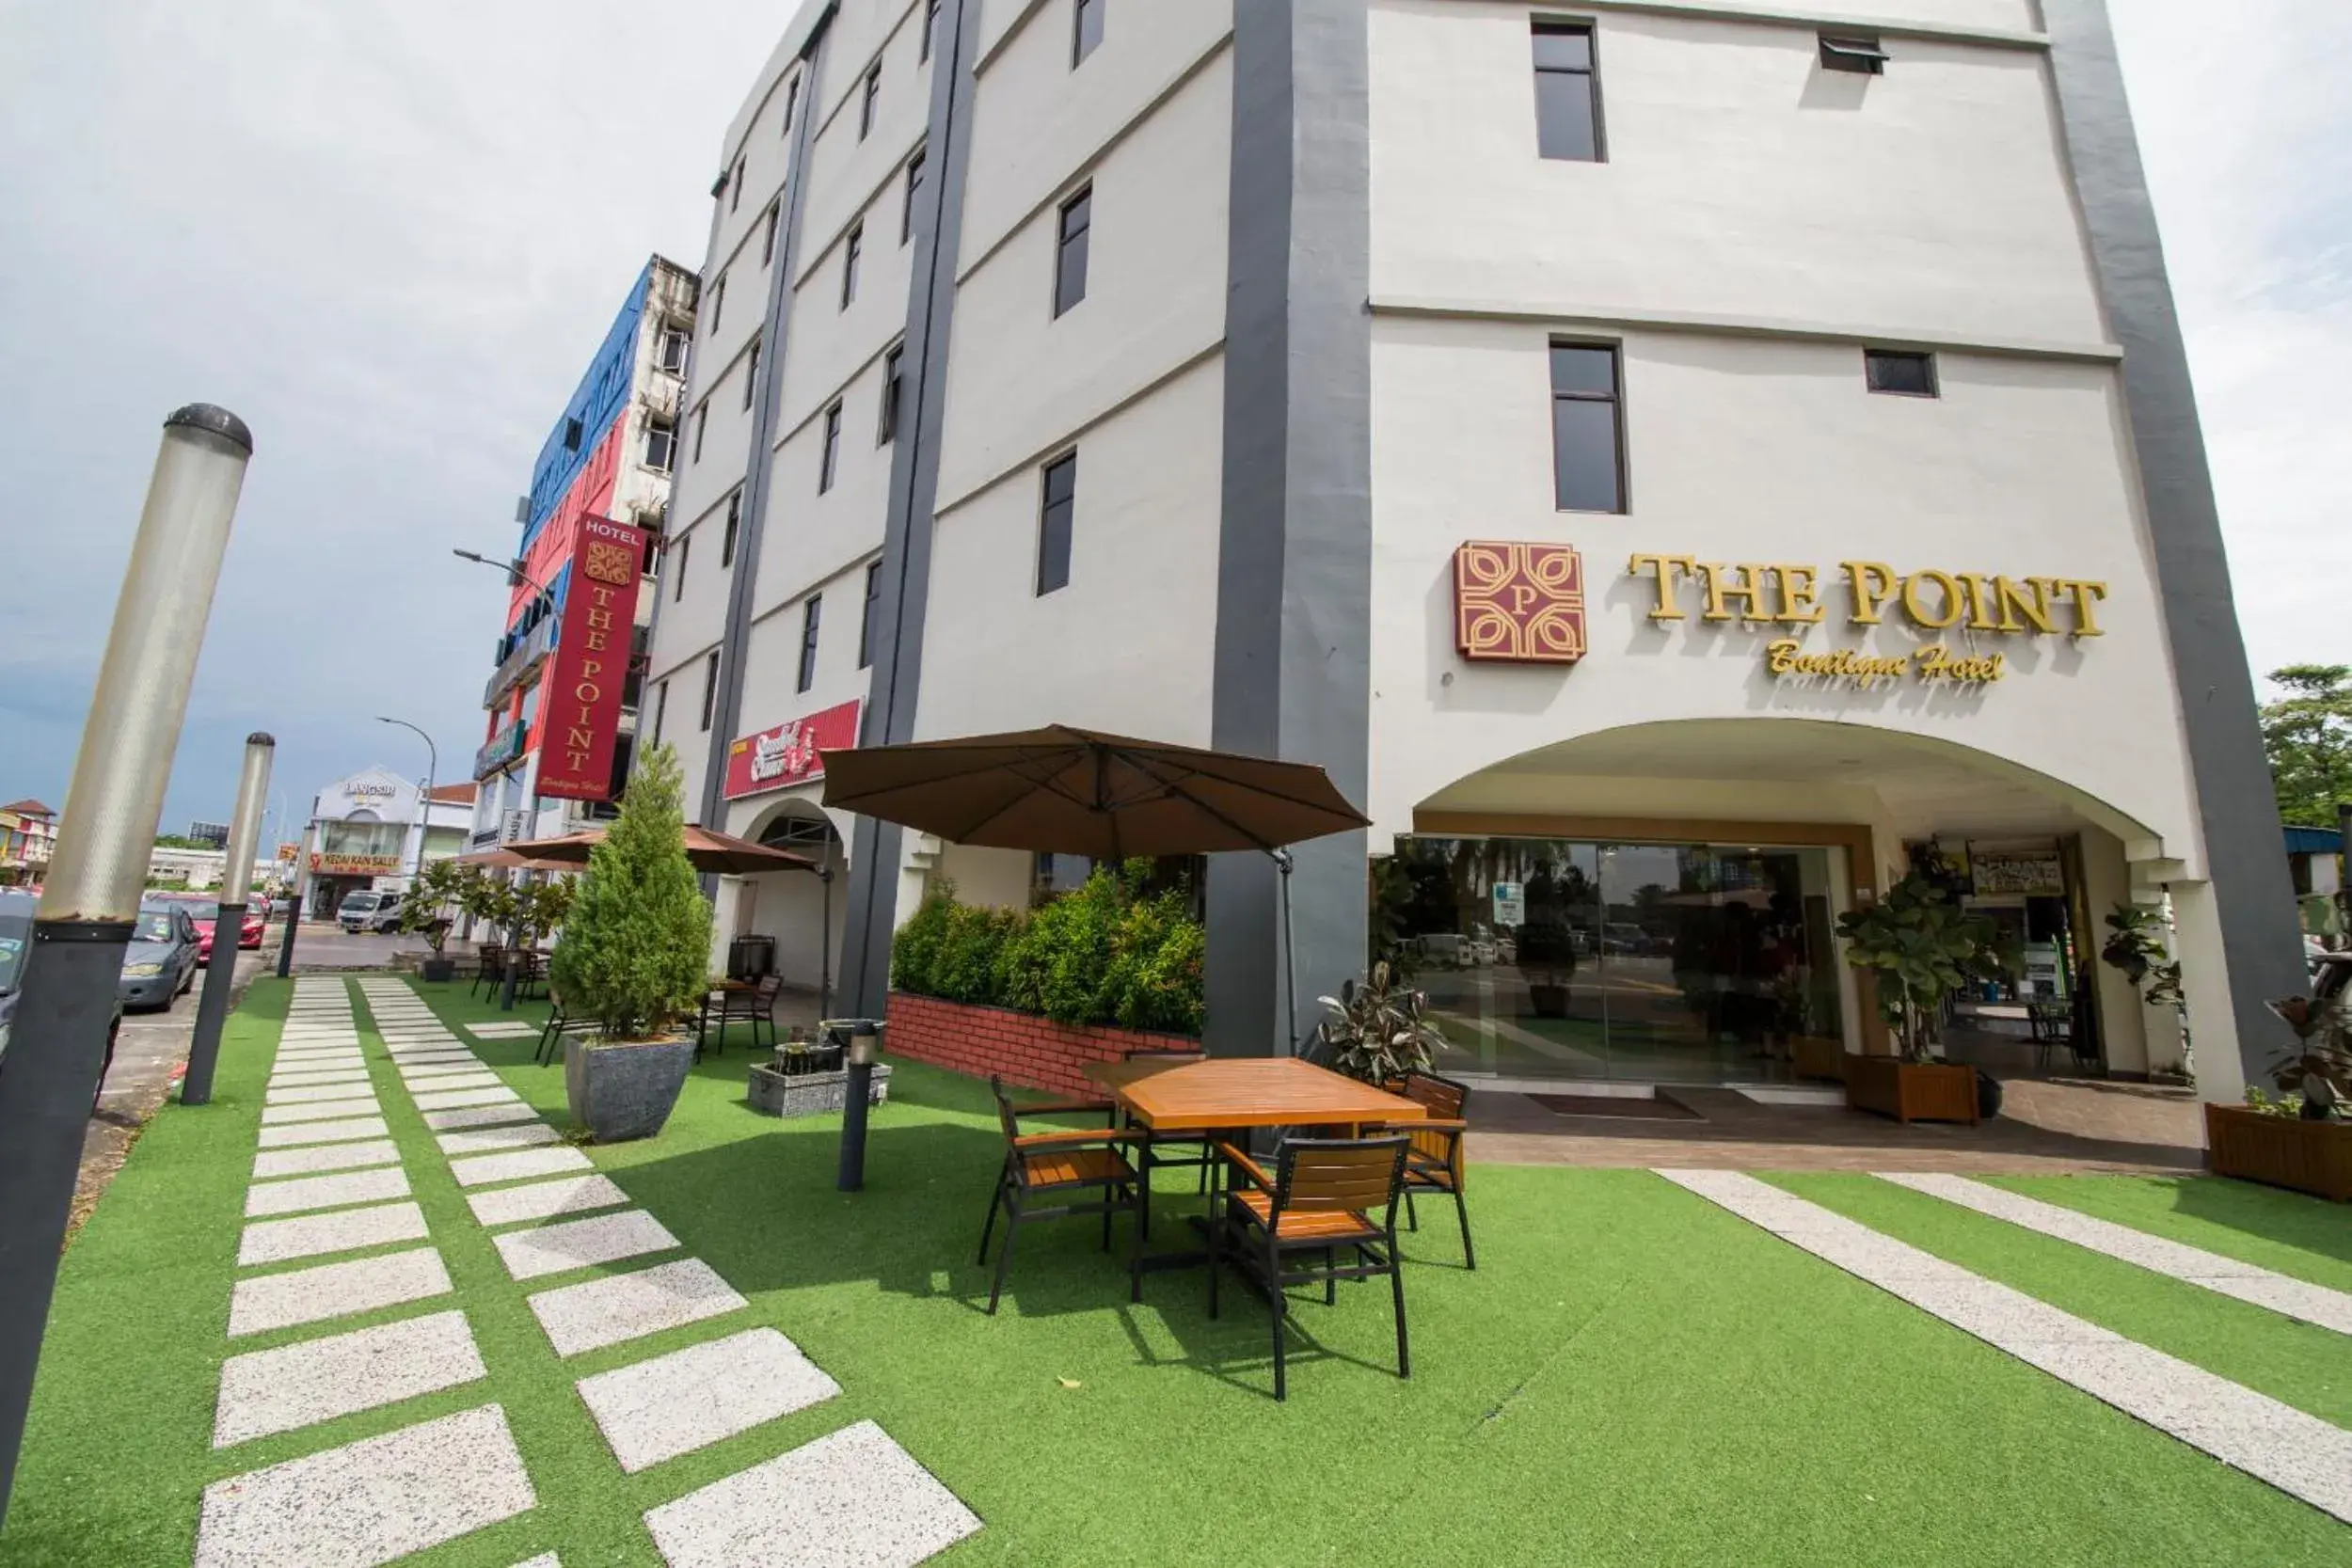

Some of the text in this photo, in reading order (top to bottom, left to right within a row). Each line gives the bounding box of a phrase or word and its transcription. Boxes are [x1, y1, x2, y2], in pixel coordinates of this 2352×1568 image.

[585, 519, 641, 546] HOTEL
[1509, 584, 1537, 616] P
[1628, 553, 2107, 637] THE POINT
[564, 586, 615, 772] THE POINT
[1765, 638, 2005, 689] Boutique Hotel
